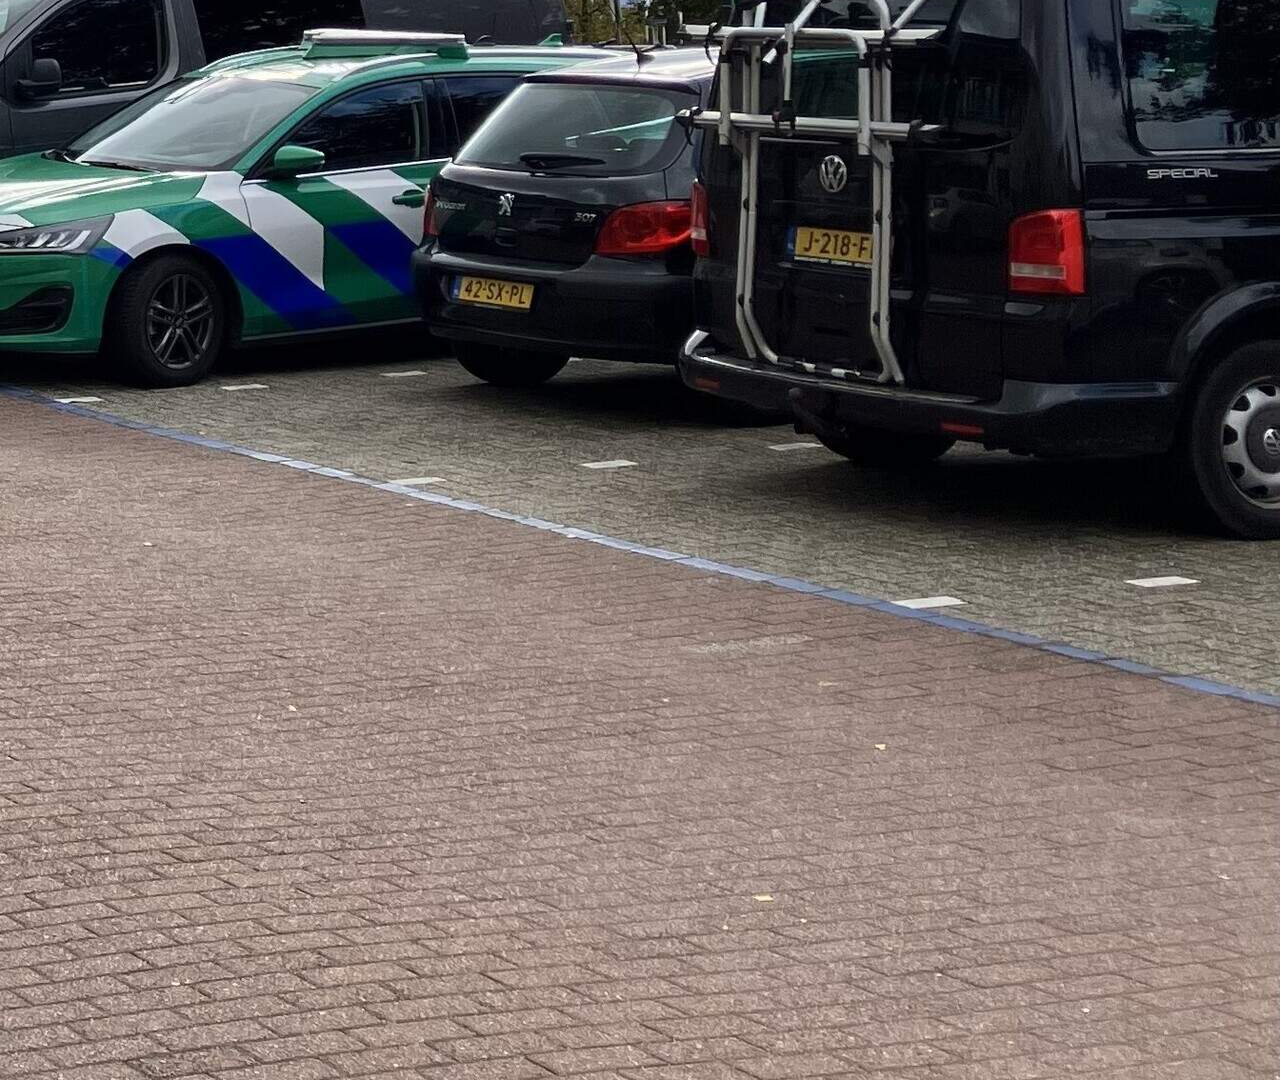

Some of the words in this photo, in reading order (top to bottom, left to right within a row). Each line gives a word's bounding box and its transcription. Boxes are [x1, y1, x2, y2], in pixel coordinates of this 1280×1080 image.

[1146, 168, 1218, 179] SPECIAL
[574, 212, 597, 223] 307
[803, 231, 873, 258] J-218-F
[465, 280, 526, 304] 42-SX-PL
